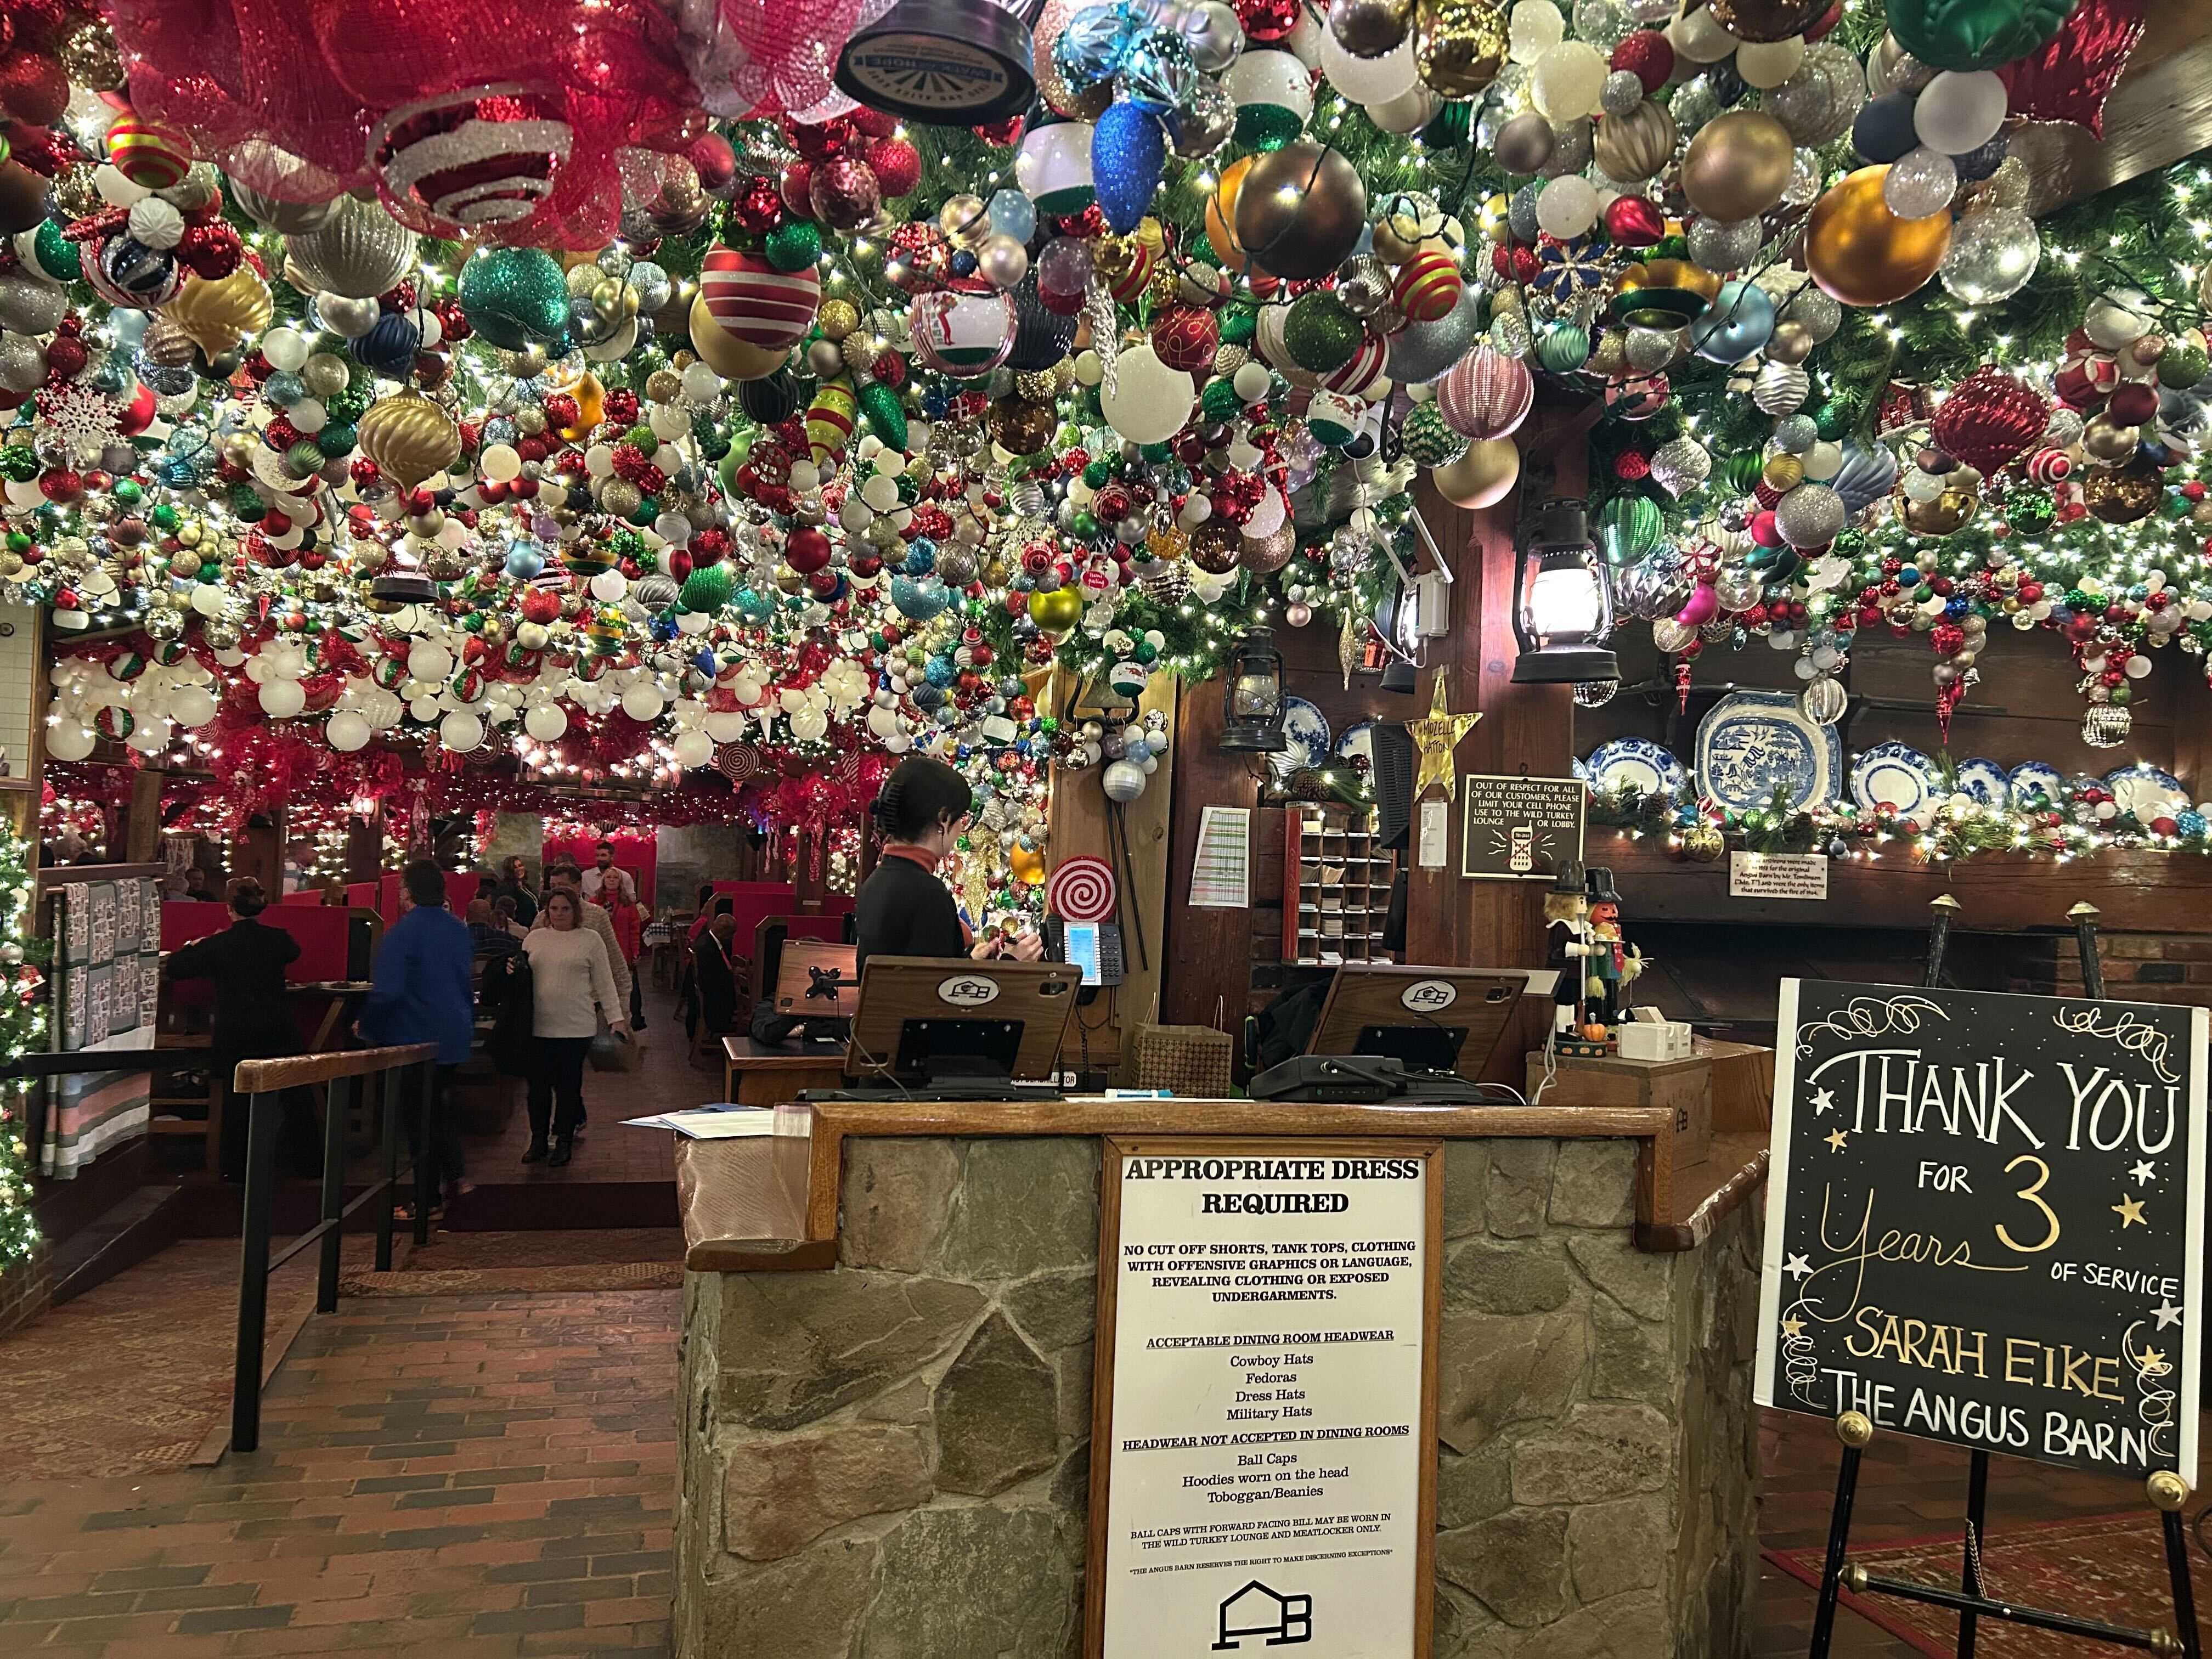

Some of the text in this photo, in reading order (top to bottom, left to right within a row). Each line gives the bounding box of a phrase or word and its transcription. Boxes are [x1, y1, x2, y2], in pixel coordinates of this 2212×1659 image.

[1423, 719, 1455, 736] MOZELLE
[1423, 740, 1449, 755] HATTON
[1506, 792, 1551, 802] CUSTOMERS,
[1805, 1049, 2180, 1155] THANK YOU
[1125, 1160, 1419, 1180] APPROPRIATE DRESS
[1202, 1194, 1348, 1215] REQUIRED
[1918, 1155, 2060, 1253] FOR 3
[1124, 1242, 1415, 1255] NO CUT OFF SHORTS, TANK TOPS, CLOTHING
[1800, 1182, 2029, 1323] Years
[1128, 1257, 1412, 1271] WITH OFFENSIVE GRAPHICS OR LANGUAGE,
[1152, 1273, 1389, 1286] REVEALING CLOTHING OR EXPOSED
[2051, 1263, 2179, 1299] OF SERVICE
[1212, 1290, 1336, 1302] UNDERGARMENTS.
[1147, 1330, 1394, 1347] ACCEPTABLE DINING ROOM HEADWEAR
[1231, 1354, 1313, 1368] Cowboy Hats
[1844, 1306, 2125, 1404] SARAH EIKE
[1246, 1373, 1296, 1384] Fedoras
[1235, 1389, 1305, 1402] Dress Hats
[1227, 1406, 1312, 1420] Military Hats
[1821, 1368, 2147, 1466] THE ANGUS BARN
[1123, 1425, 1409, 1450] HEADWEAR NOT ACCEPTED IN DINING ROOMS
[1238, 1453, 1297, 1466] Ball Caps
[1182, 1466, 1348, 1487] Hoodies worn on the head
[1207, 1486, 1323, 1503] Toboggan/Beanies
[1131, 1530, 1155, 1539] BALL
[1158, 1528, 1181, 1536] CAPS
[1183, 1526, 1207, 1534] WITH
[1210, 1522, 1255, 1532] FORWARD
[1257, 1520, 1290, 1528] FACING
[1351, 1514, 1379, 1522] WORN
[1142, 1541, 1161, 1549] THE
[1190, 1536, 1228, 1545] TURKEY
[1231, 1532, 1268, 1542] LOUNGE
[1293, 1527, 1354, 1537] MEATLOCKER
[1357, 1525, 1381, 1533] ONLY.
[1149, 1565, 1172, 1573] ANGUS
[1175, 1564, 1194, 1572] BARN
[1197, 1561, 1232, 1570] RESERVES
[1305, 1552, 1346, 1561] DISCERNING
